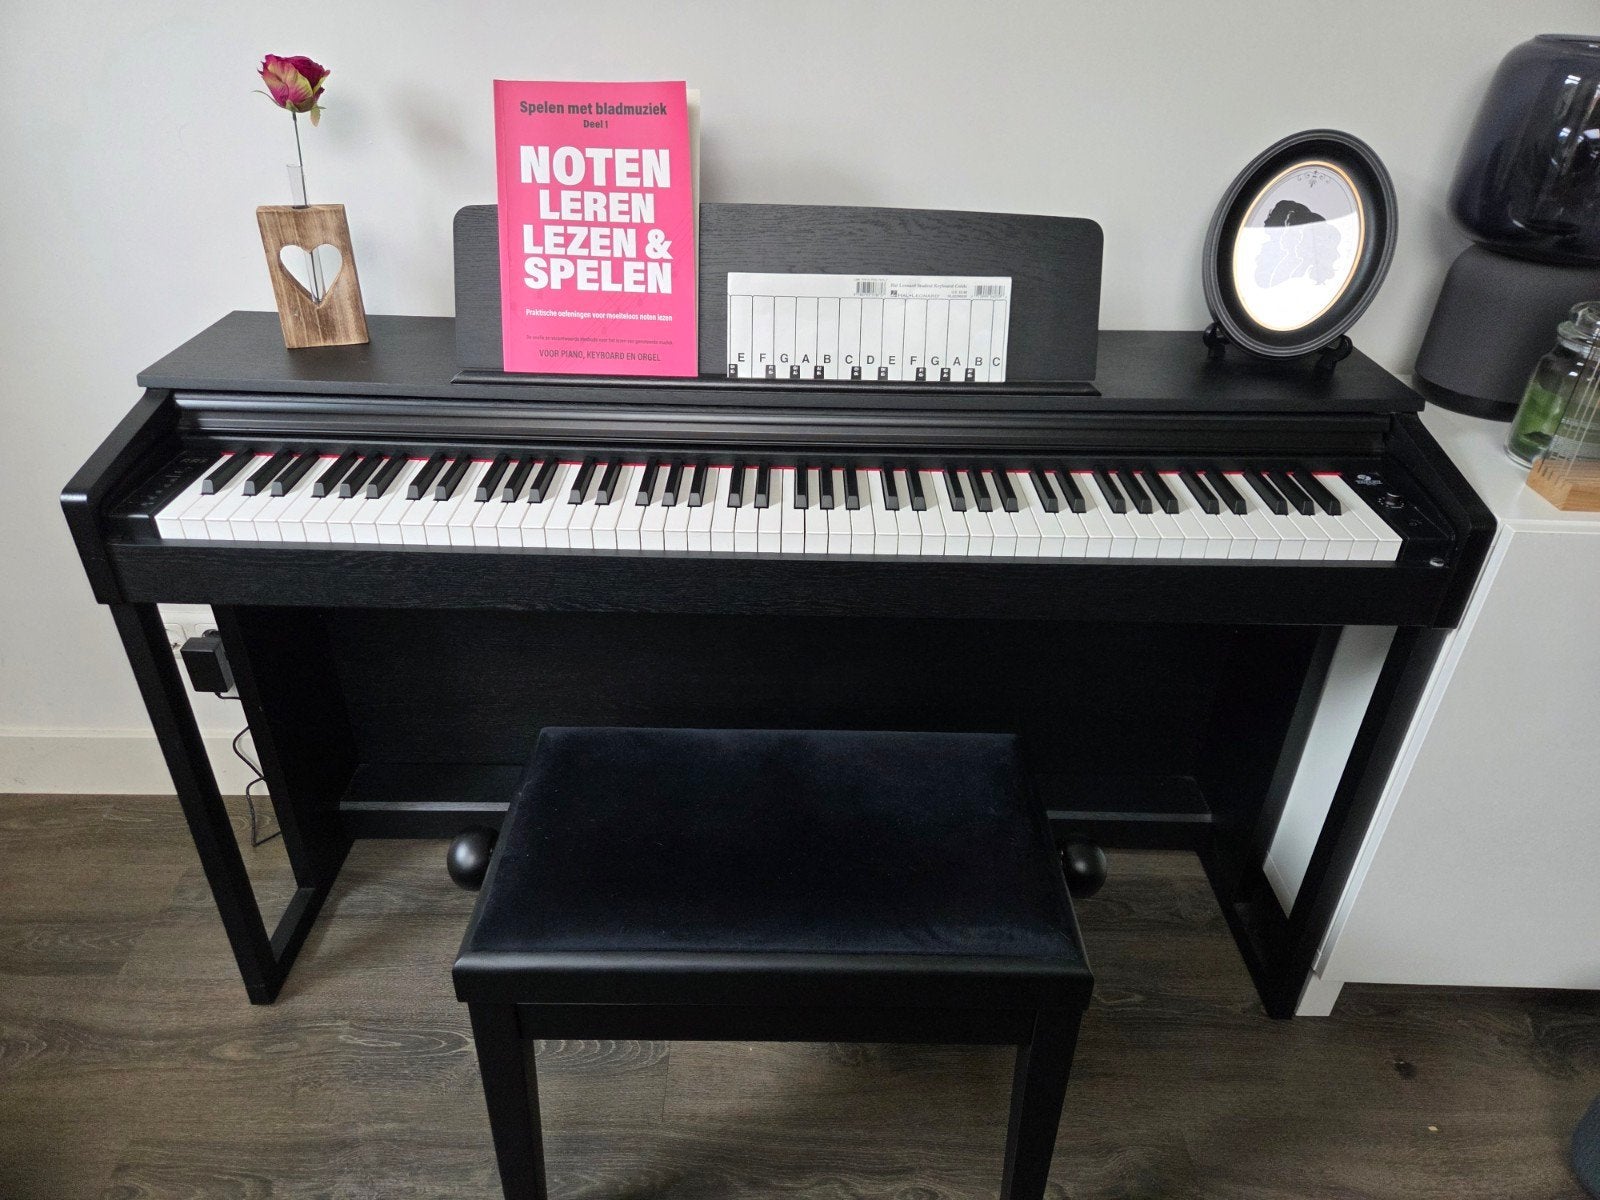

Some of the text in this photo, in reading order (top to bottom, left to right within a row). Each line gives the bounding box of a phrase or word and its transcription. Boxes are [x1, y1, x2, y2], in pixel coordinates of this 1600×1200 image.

[520, 101, 667, 115] Spelen met bladmuziek
[583, 119, 609, 128] Deel 1
[519, 145, 671, 188] NOTEN
[539, 189, 655, 224] LEREN
[523, 224, 673, 260] LEZEN &
[523, 256, 673, 294] SPELEN
[525, 308, 557, 317] Praktische
[639, 313, 657, 321] noten
[657, 314, 673, 322] lezen
[539, 349, 661, 362] VOOR PIANO, KEYBOARD EN ORGEL
[738, 353, 1001, 366] E F G A B C D E F G A B C
